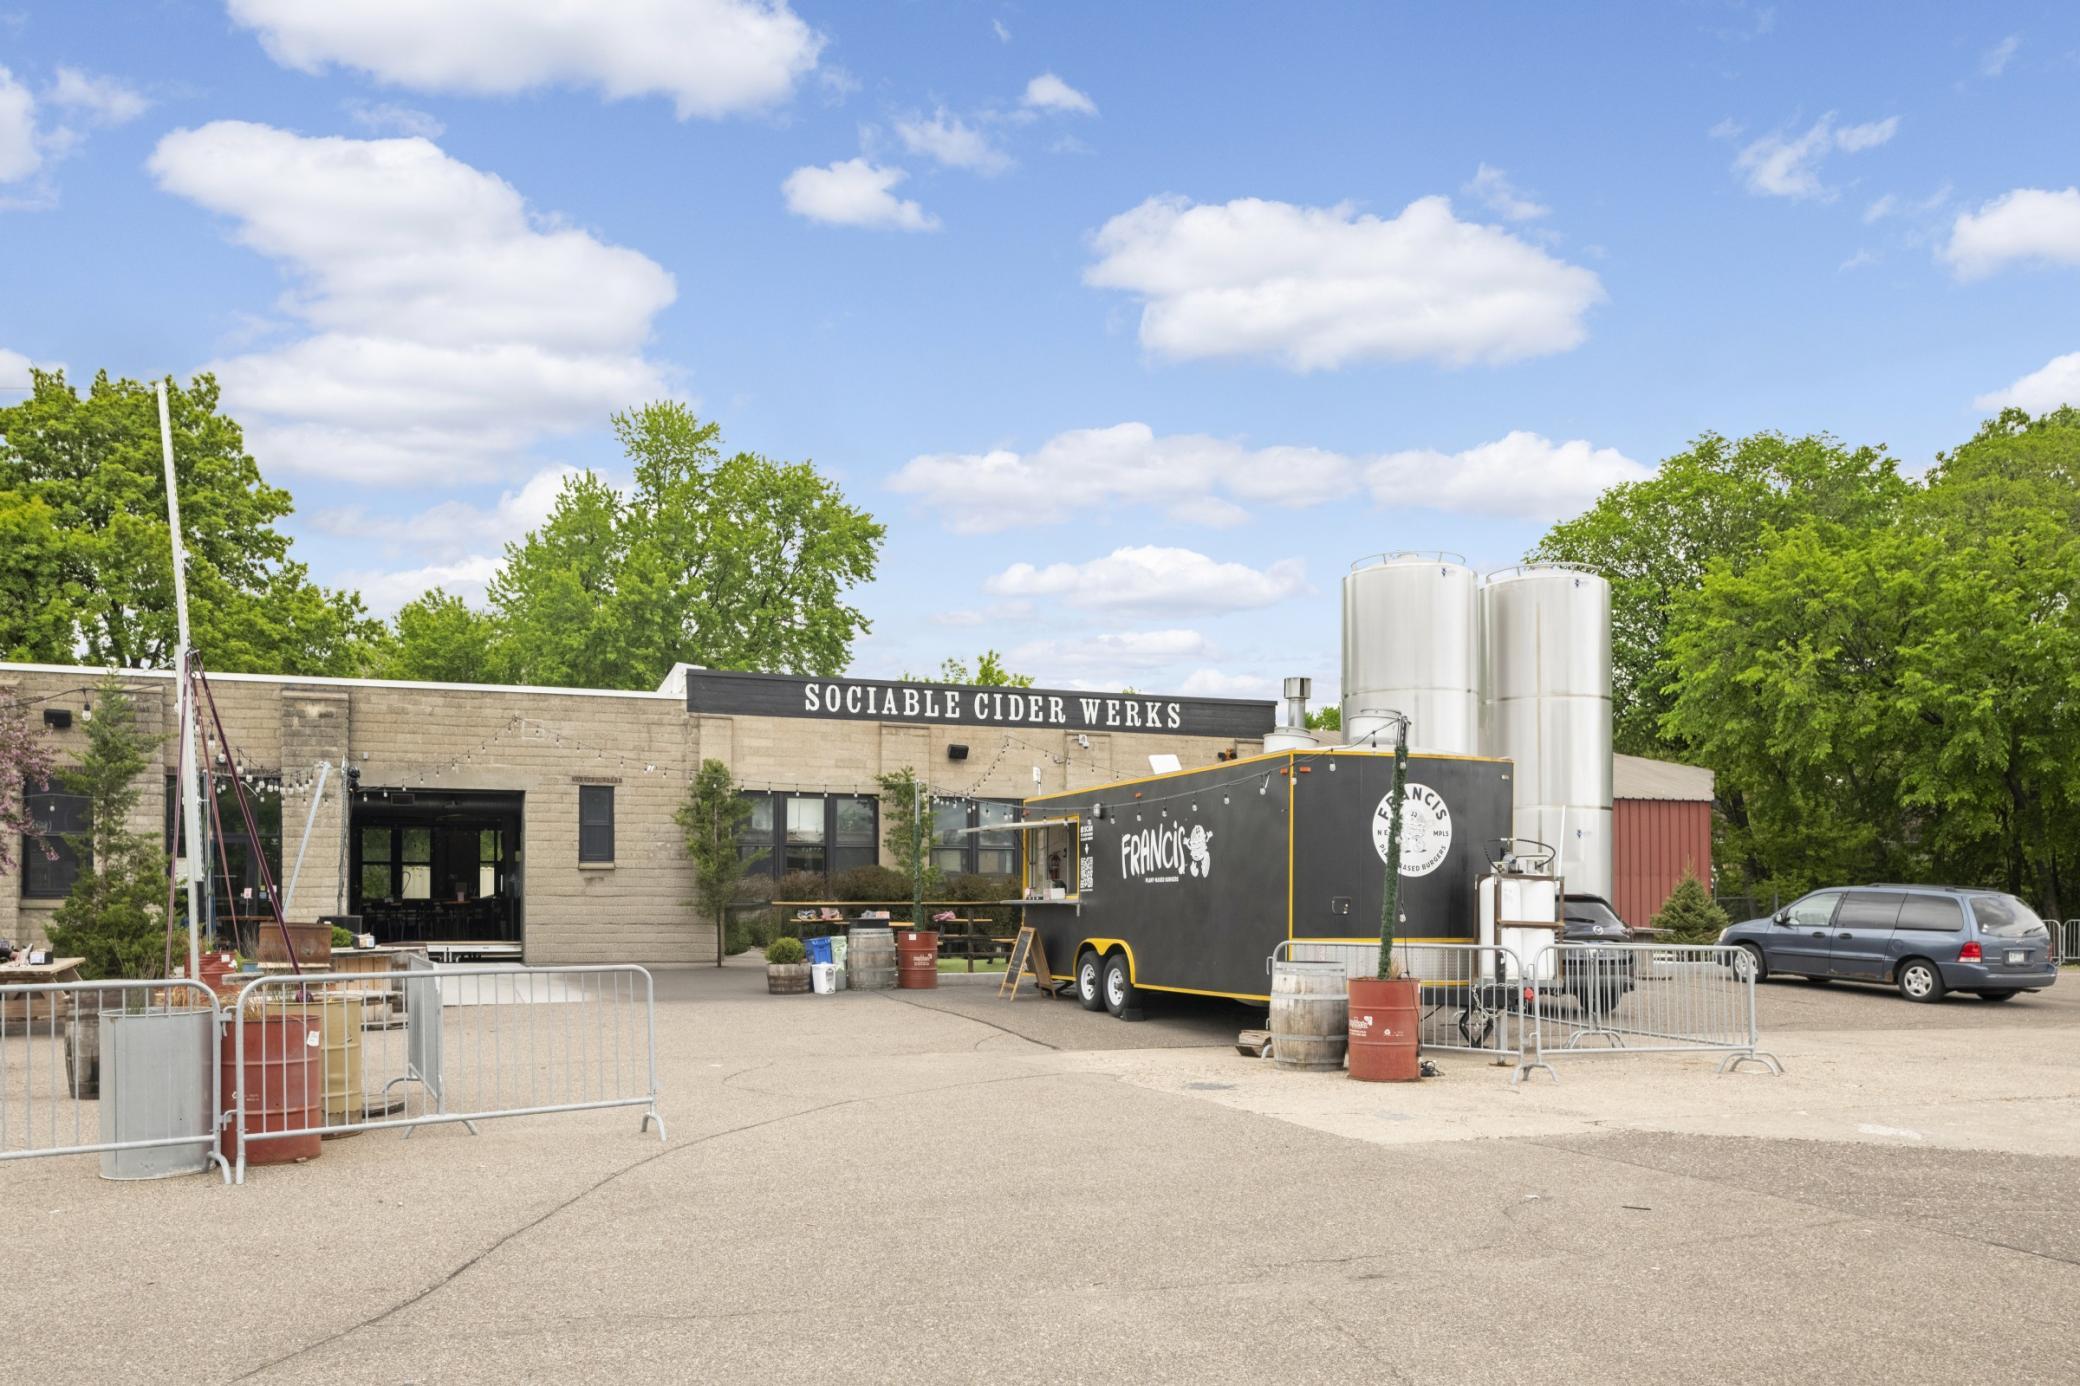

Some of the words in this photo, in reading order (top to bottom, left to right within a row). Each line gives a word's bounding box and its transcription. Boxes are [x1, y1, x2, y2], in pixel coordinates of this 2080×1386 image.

[805, 683, 960, 718] SOCIABLE
[974, 693, 1066, 724] CIDER
[1080, 698, 1181, 729] WERKS
